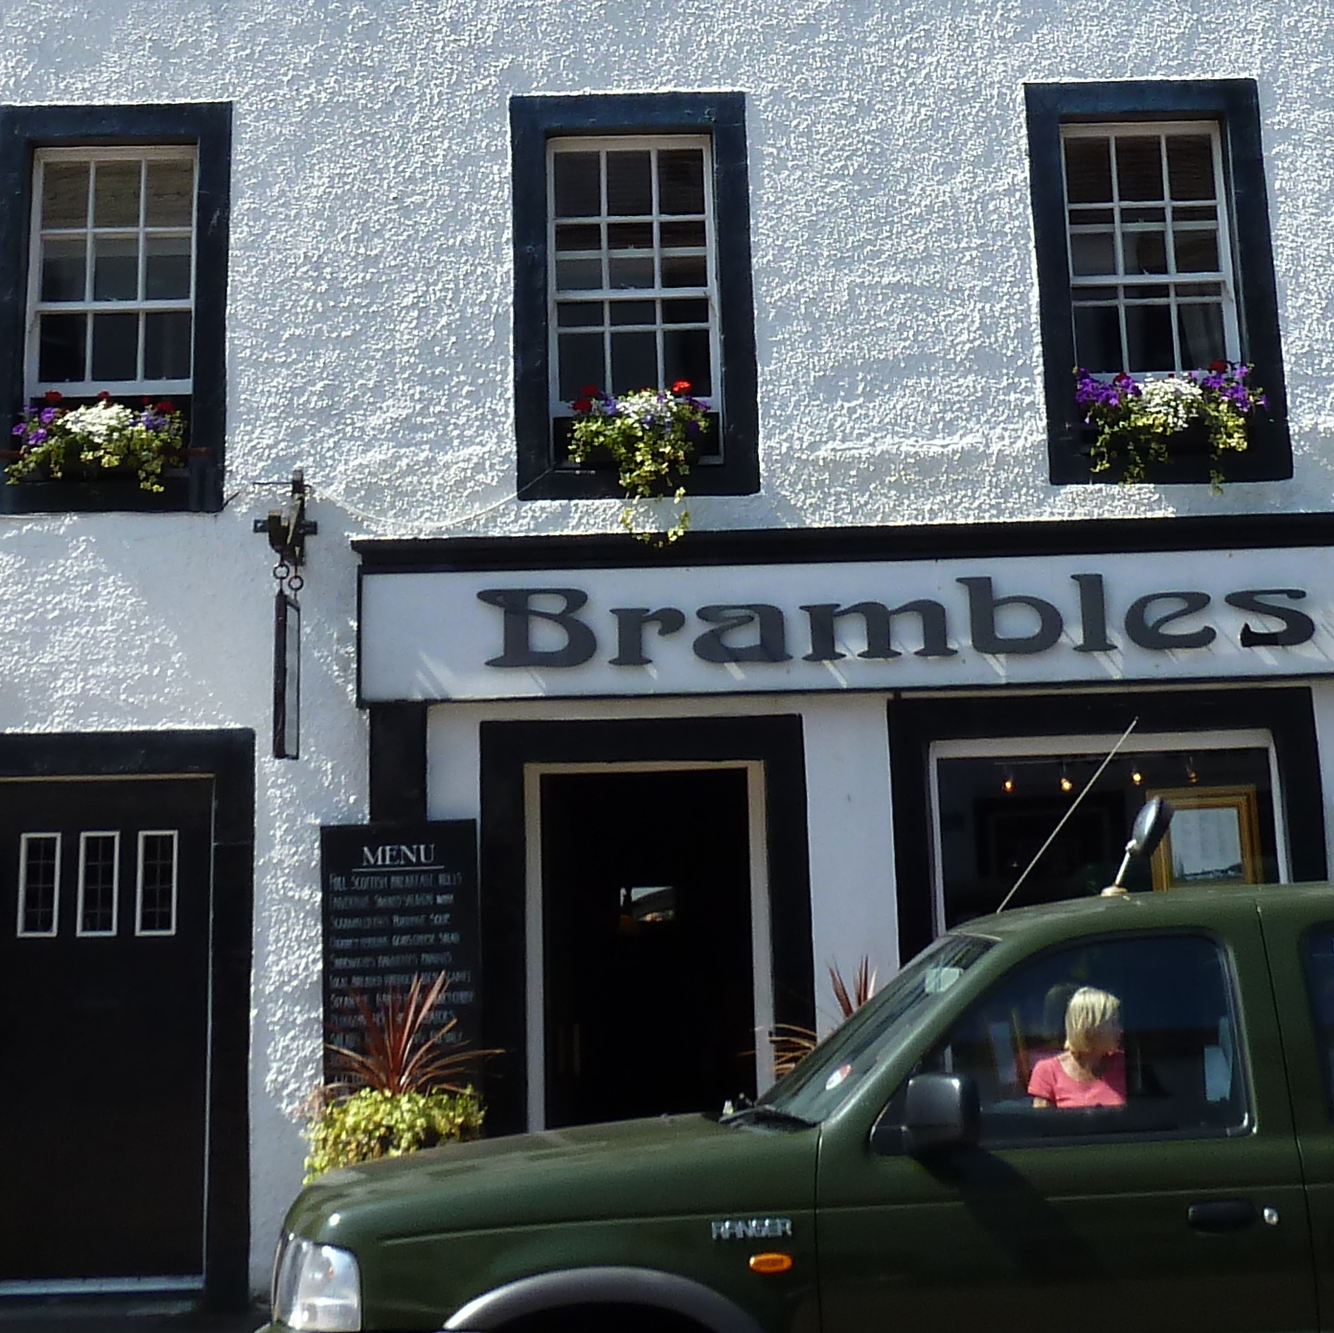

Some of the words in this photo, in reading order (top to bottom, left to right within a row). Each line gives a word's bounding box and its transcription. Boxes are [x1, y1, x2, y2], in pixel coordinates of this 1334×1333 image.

[476, 573, 1317, 668] Brambles
[363, 844, 436, 866] MENU
[711, 1218, 793, 1240] RANGER
